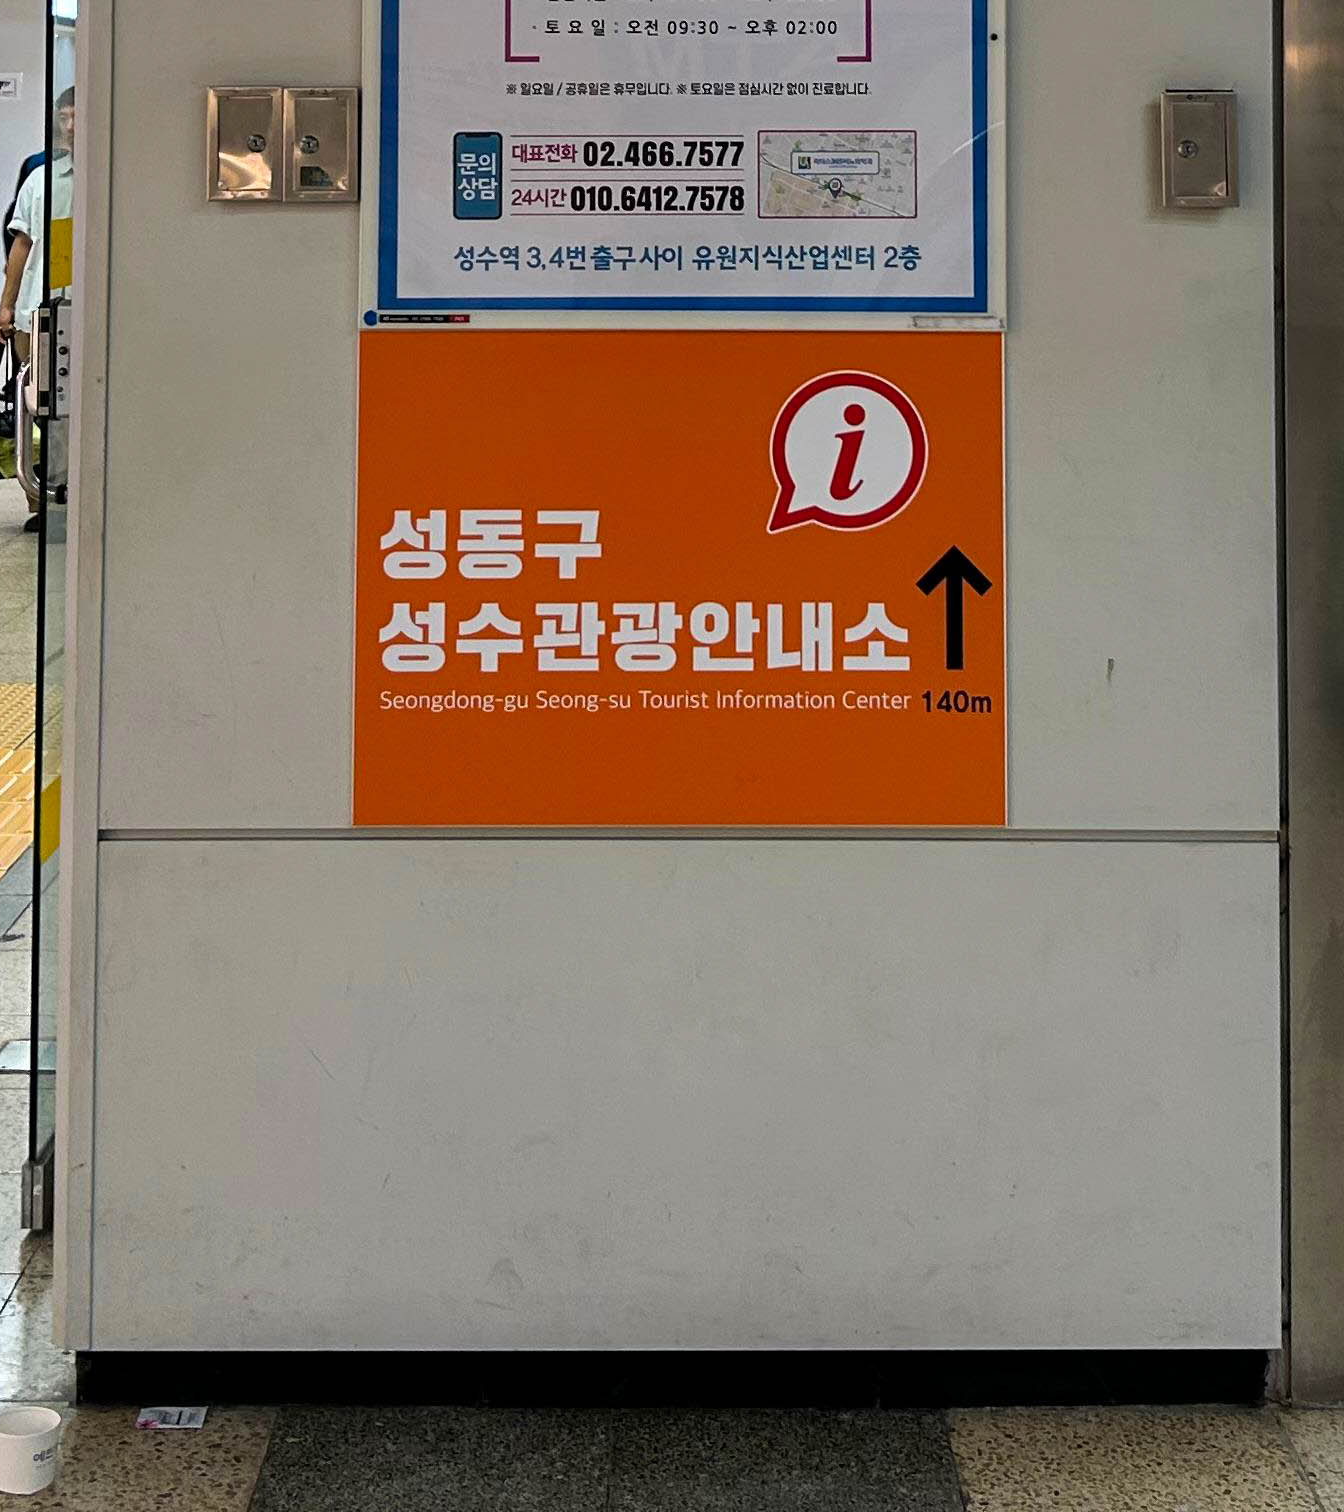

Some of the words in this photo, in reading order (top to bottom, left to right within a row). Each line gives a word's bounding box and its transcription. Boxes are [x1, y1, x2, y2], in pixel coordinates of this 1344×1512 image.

[626, 19, 659, 37] 오전
[667, 20, 719, 35] 09:30
[744, 19, 779, 37] 오후
[785, 20, 838, 35] 02:00
[520, 82, 554, 96] 일요일
[565, 82, 611, 96] 공휴일은
[613, 82, 673, 96] 휴무입니다.
[690, 82, 736, 96] 토요일은
[738, 82, 784, 96] 점심시간
[786, 82, 809, 96] 없이
[812, 82, 872, 96] 진료합니다.
[457, 153, 496, 176] 문의
[512, 143, 578, 164] 대표전화
[584, 141, 745, 167] 02.466.7577
[457, 177, 499, 201] 상담
[512, 188, 567, 208] 24시간
[570, 186, 745, 212] 010.6412.7578
[453, 246, 520, 272] 성수역
[691, 245, 875, 271] 유원지식산업센터
[883, 245, 922, 271] 2층
[379, 509, 603, 580] 성동구
[378, 601, 911, 673] 성수관광안내소
[379, 690, 529, 713] Seongdong-gu
[535, 690, 631, 713] Seong-su
[638, 690, 709, 709] Tourist
[716, 690, 835, 709] Information
[842, 690, 912, 710] Center
[921, 689, 993, 714] 140m
